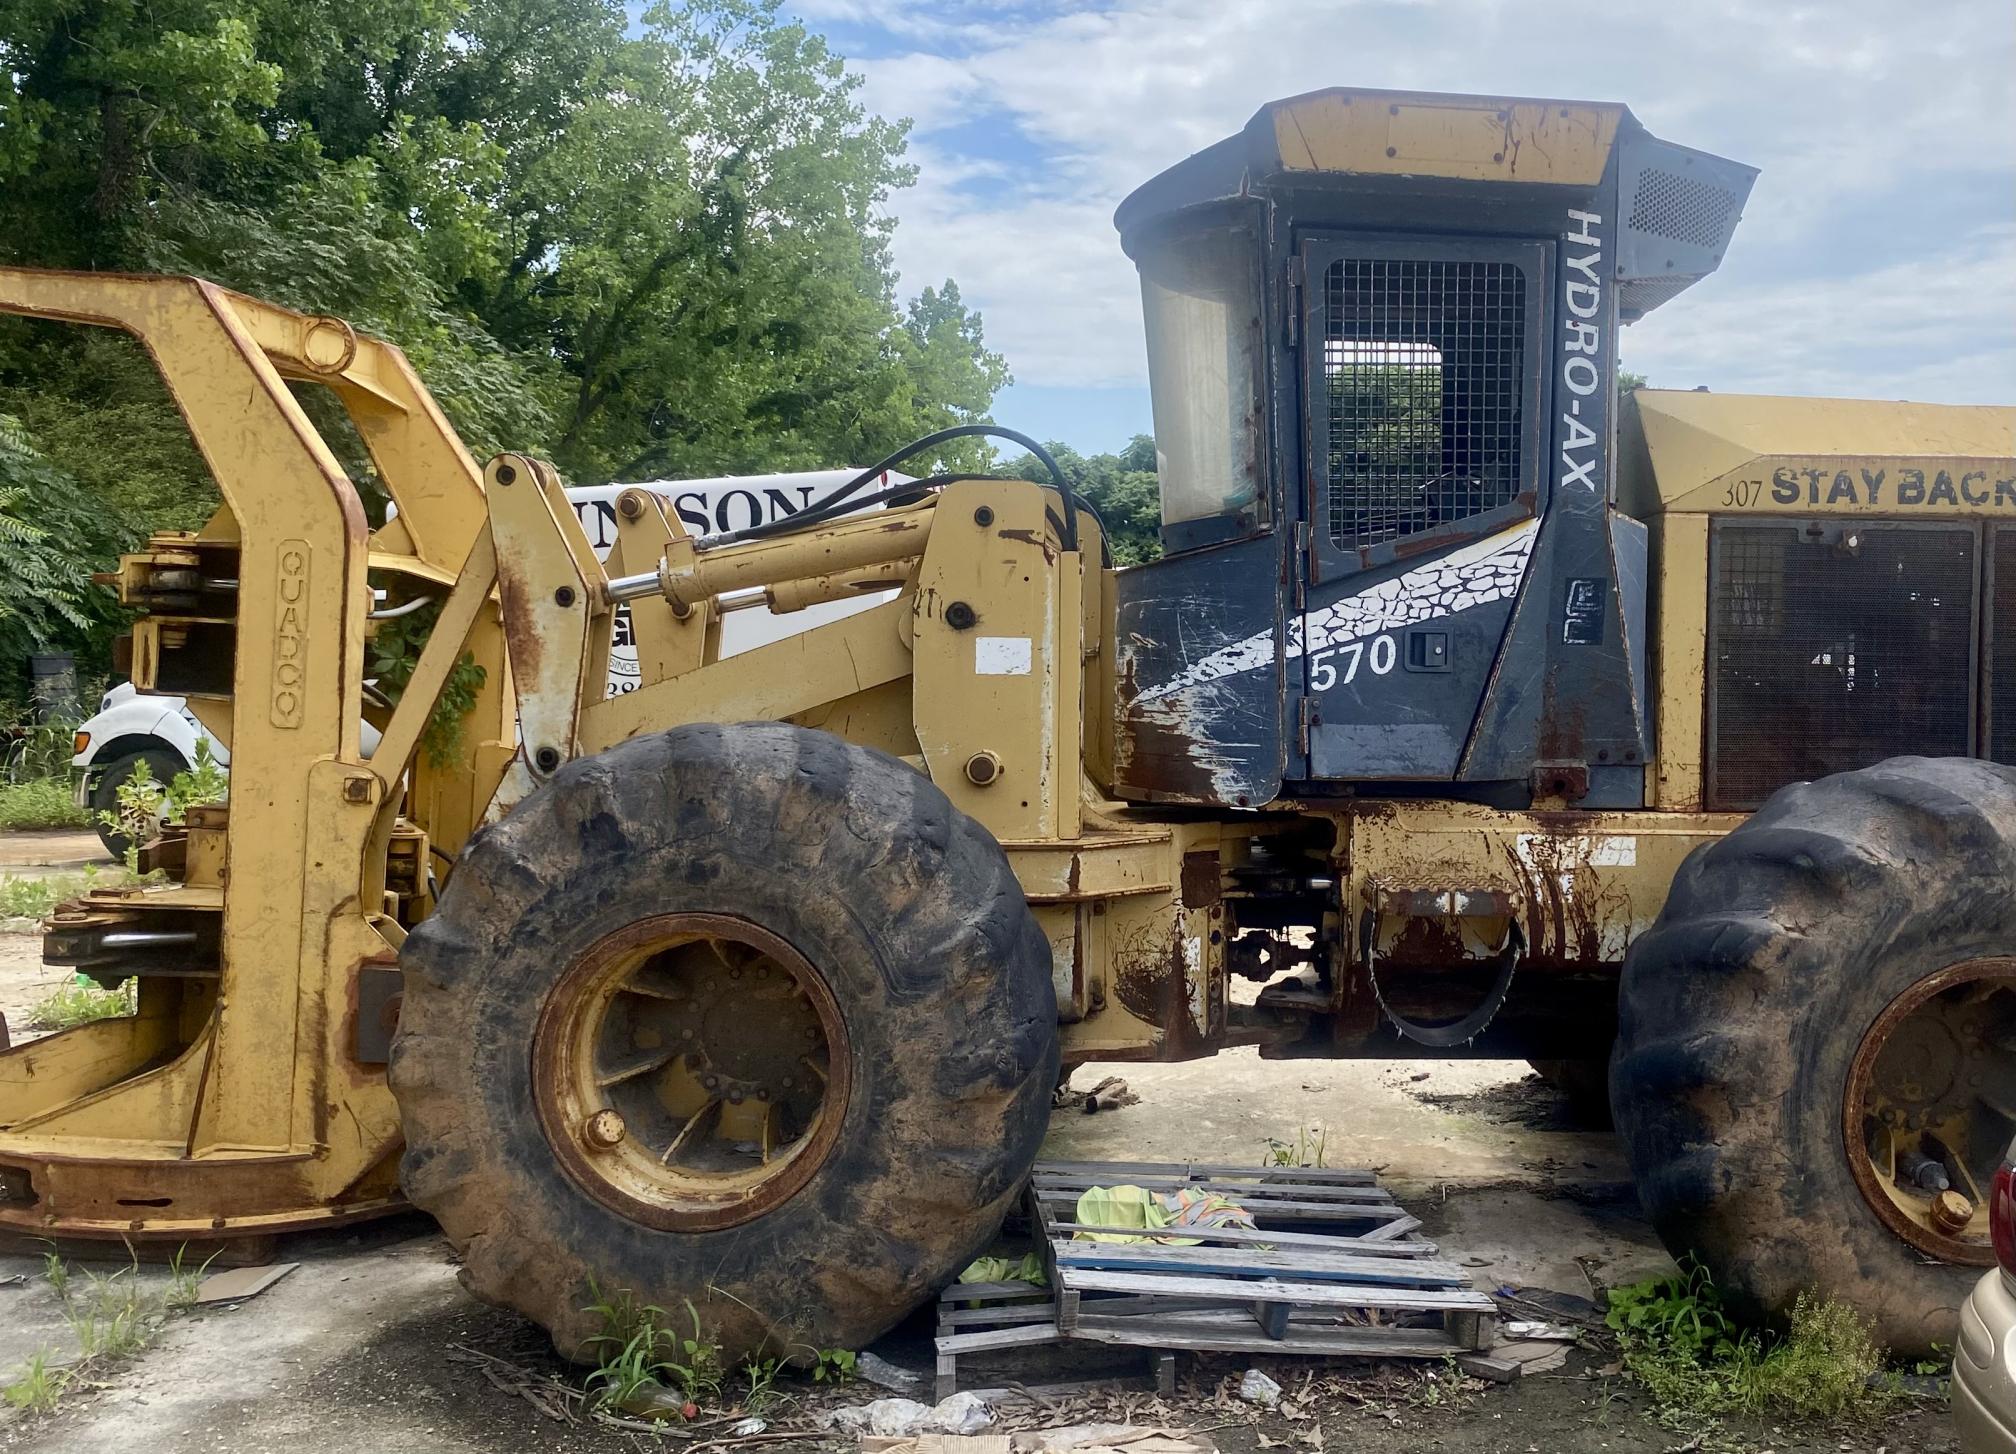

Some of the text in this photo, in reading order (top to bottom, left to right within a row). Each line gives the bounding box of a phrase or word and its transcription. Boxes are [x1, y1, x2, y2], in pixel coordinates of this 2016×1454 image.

[1561, 208, 1602, 493] HYDRO-AX
[1721, 480, 1762, 507] 307
[1771, 467, 2016, 506] STAY BACK
[275, 551, 304, 716] QUADCO
[609, 658, 638, 673] SINCE
[1310, 634, 1396, 692] 570
